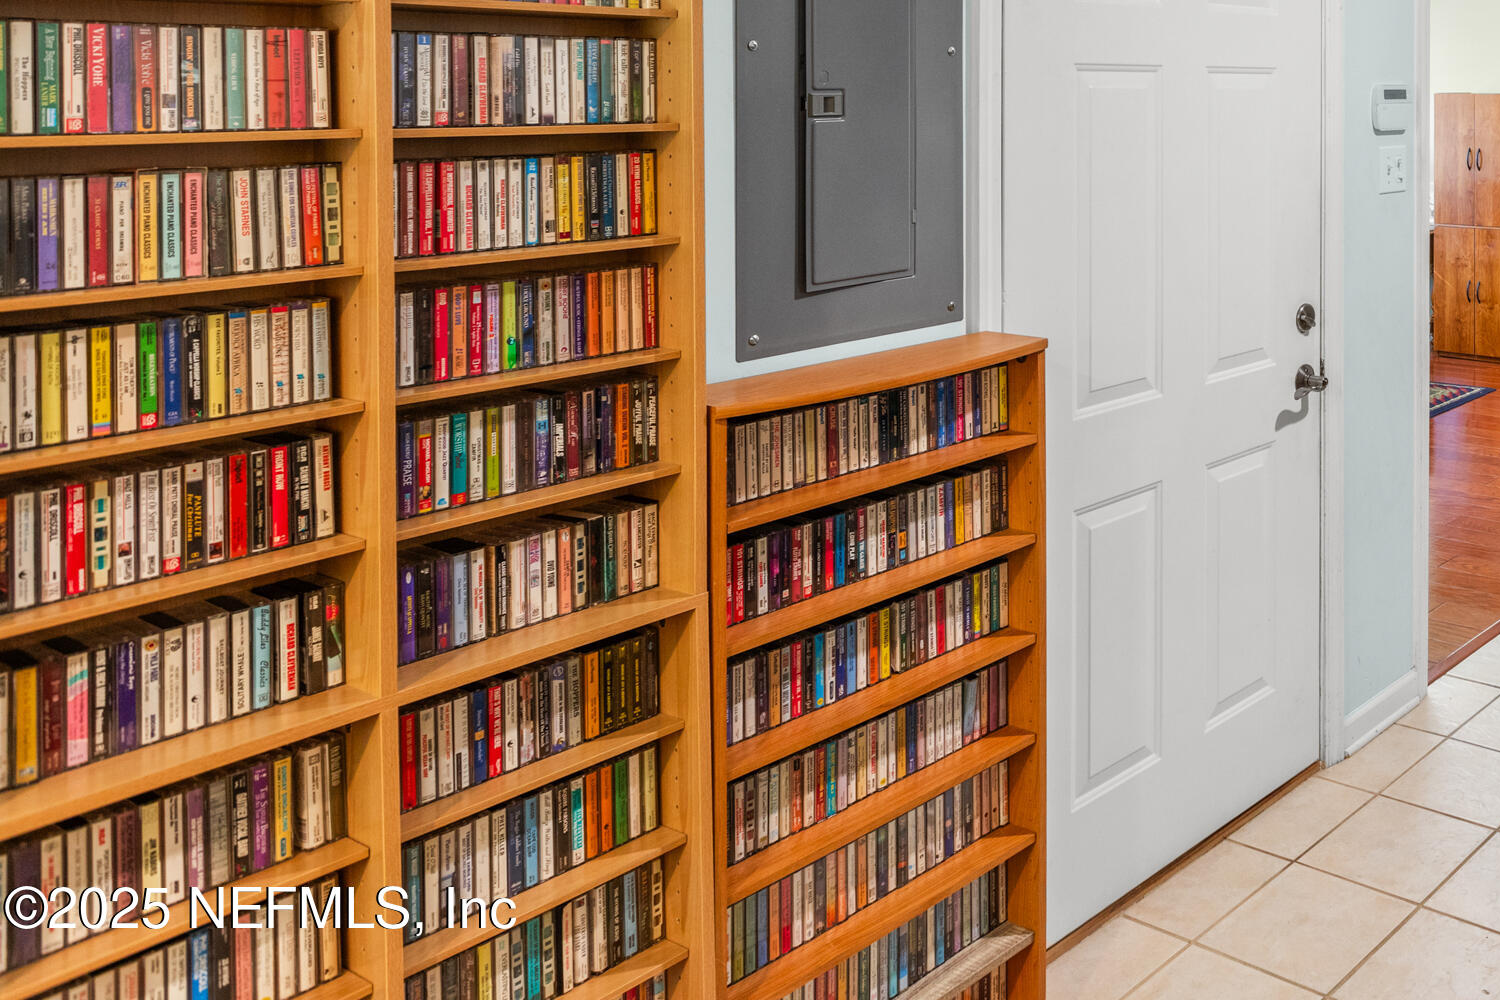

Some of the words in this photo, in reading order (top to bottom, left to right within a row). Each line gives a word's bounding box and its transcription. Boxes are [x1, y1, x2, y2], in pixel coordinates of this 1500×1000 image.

[93, 28, 105, 56] VICKI
[92, 58, 105, 87] YOHE
[143, 182, 151, 214] ENCHANTED
[166, 181, 175, 213] ENCHANTED
[240, 177, 248, 199] JOHN
[143, 215, 151, 232] PIANO
[167, 214, 175, 231] PIANO
[241, 200, 250, 236] STARNES
[190, 231, 198, 255] CLASSICS
[275, 450, 283, 474] FRONT
[402, 460, 413, 486] PRAISE
[275, 474, 284, 491] ROW
